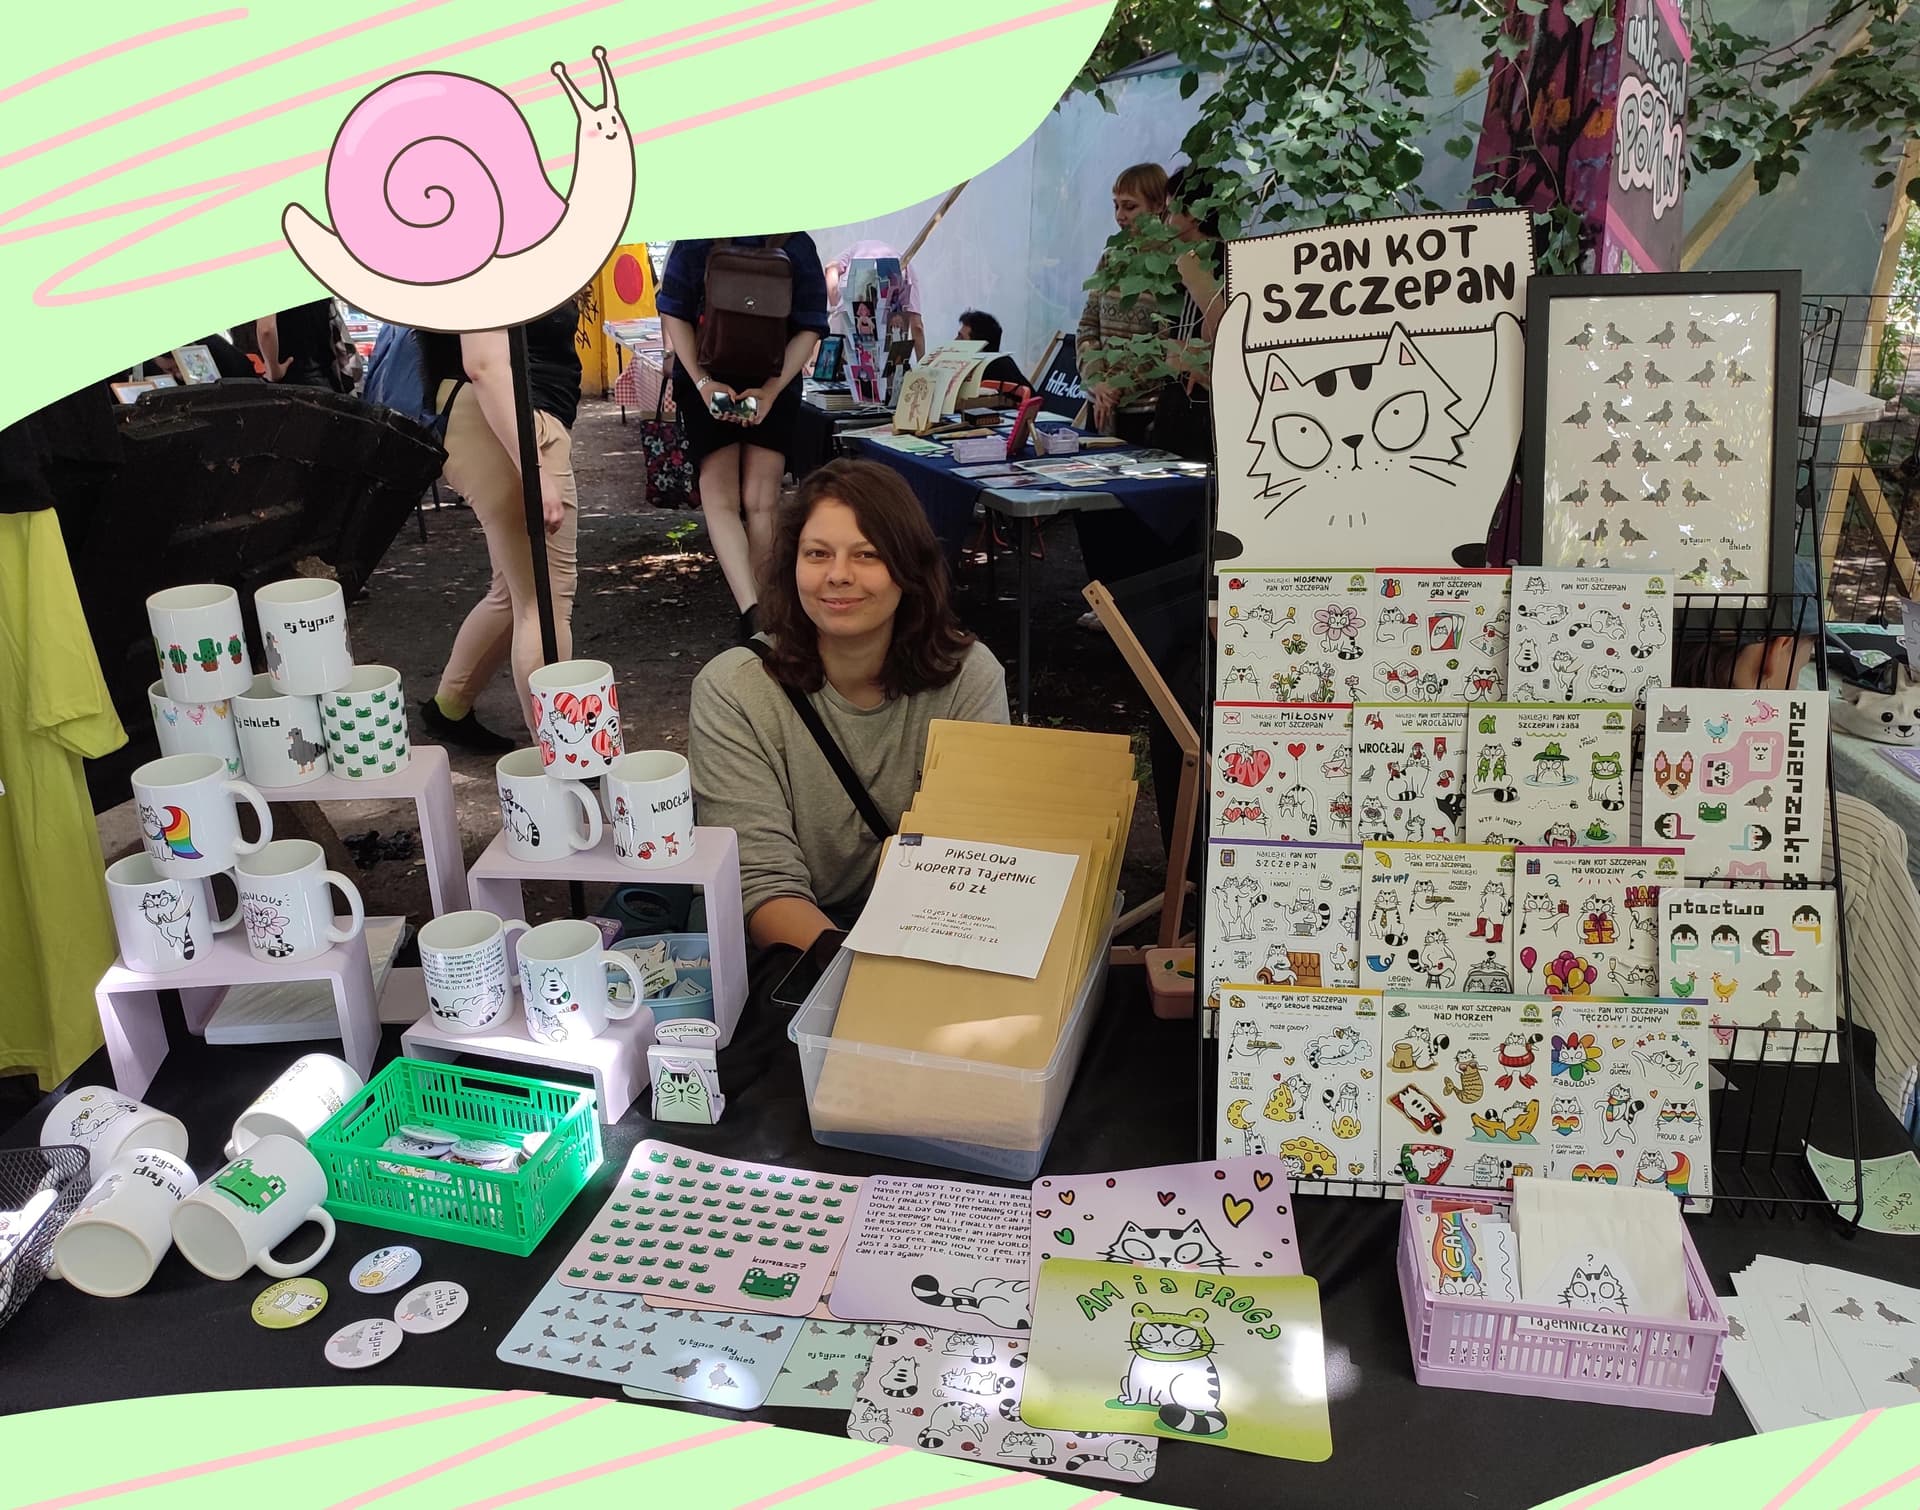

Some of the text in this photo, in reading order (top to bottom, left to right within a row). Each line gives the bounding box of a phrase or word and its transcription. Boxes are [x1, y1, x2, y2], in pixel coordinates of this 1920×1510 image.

[1386, 225, 1478, 268] KOT
[1280, 584, 1293, 592] KOT
[283, 613, 336, 635] ej typie
[243, 716, 281, 729] chleb
[1567, 713, 1580, 721] KOT
[1593, 858, 1607, 866] KOT
[1393, 873, 1410, 884] UP!
[949, 881, 988, 895] 60 ZŁ
[1669, 899, 1765, 921] ptactwo
[1296, 995, 1310, 1003] KOT
[1461, 1004, 1474, 1012] KOT
[1631, 1015, 1662, 1024] DUMNY
[1656, 1132, 1678, 1141] PROUD
[131, 1164, 164, 1188] daj
[869, 1202, 895, 1210] DOWN
[969, 1213, 1001, 1221] COUCH?
[951, 1242, 972, 1250] HOW
[1441, 1219, 1465, 1273] GAY
[751, 1255, 807, 1272] kumasz?
[1076, 1280, 1125, 1321] AM
[1195, 1279, 1281, 1340] FROG?
[721, 1345, 739, 1356] daj
